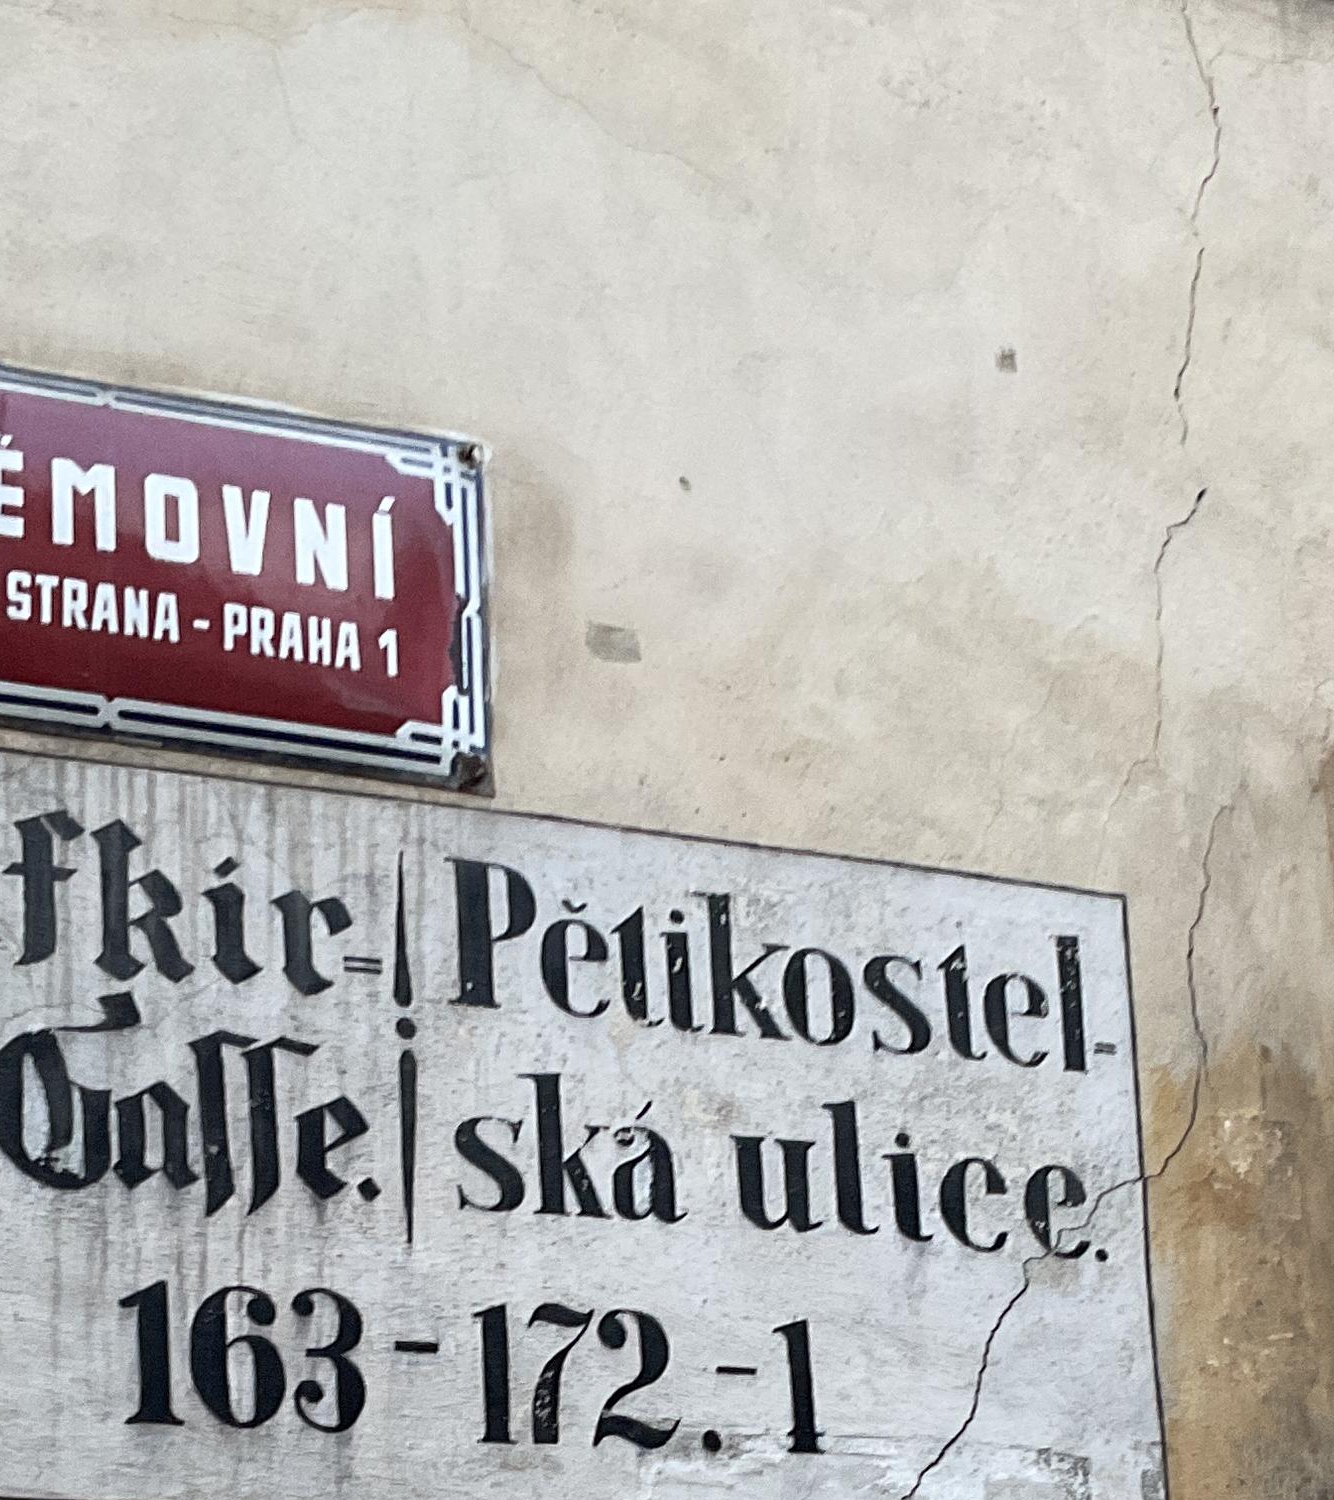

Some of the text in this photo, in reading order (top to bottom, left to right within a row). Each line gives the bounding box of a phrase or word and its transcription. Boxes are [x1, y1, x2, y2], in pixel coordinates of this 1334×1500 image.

[377, 628, 401, 679] 1
[456, 1072, 1110, 1263] ská ulice.
